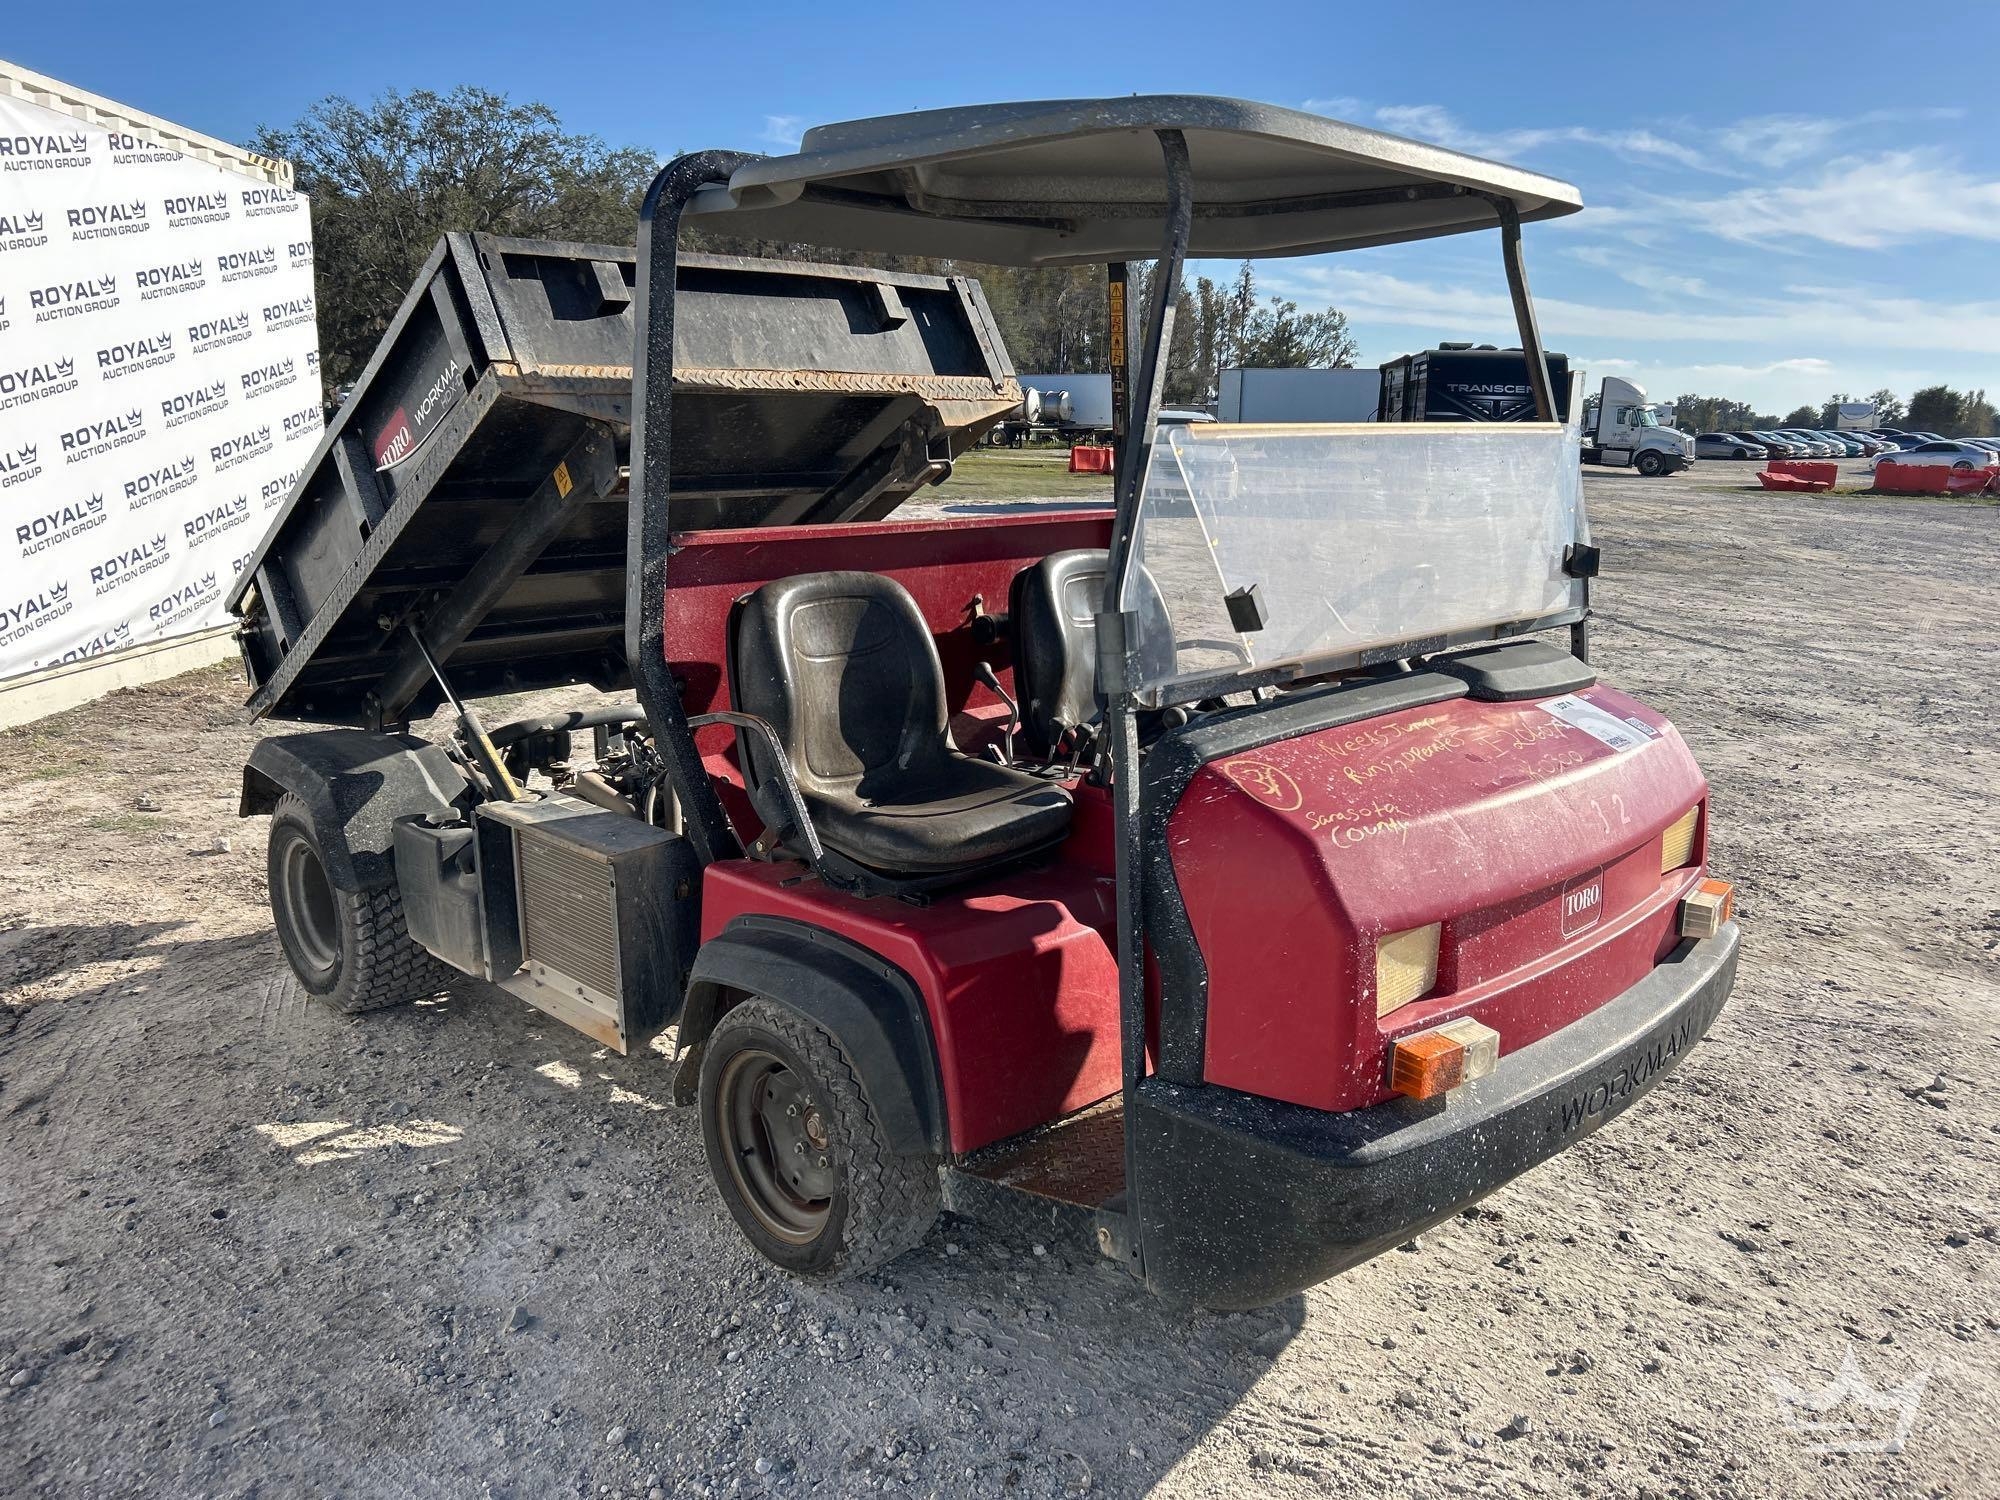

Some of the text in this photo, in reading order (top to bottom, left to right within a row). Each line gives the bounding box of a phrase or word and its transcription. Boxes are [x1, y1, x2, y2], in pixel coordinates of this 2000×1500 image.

[0, 135, 71, 156] ROYAL
[113, 152, 184, 164] AUCTION GROUP
[4, 157, 91, 171] AUCTION GROUP
[164, 195, 215, 215] ROYAL
[242, 189, 286, 206] ROYAL
[246, 204, 298, 218] AUCTION GROUP
[66, 204, 132, 227] ROYAL
[169, 212, 230, 228] AUCTION GROUP
[9, 236, 48, 250] GROUP
[72, 223, 150, 241] AUCTION GROUP
[218, 250, 264, 271] ROYAL
[222, 265, 278, 283] AUCTION GROUP
[136, 264, 190, 288] ROYAL
[30, 280, 100, 308] ROYAL
[140, 280, 206, 301] AUCTION GROUP
[36, 298, 120, 323] AUCTION GROUP
[263, 300, 304, 322] ROYAL
[188, 317, 238, 342] ROYAL
[266, 318, 294, 333] AUCTION
[97, 338, 158, 368] ROYAL
[193, 330, 252, 355] AUCTION GROUP
[0, 364, 57, 394] OYAL
[102, 352, 176, 381] AUCTION GROUP
[241, 363, 284, 389] ROYAL
[41, 380, 78, 398] GROUP
[162, 387, 213, 416] ROYAL
[246, 375, 296, 400] AUCTION GROUP
[414, 360, 459, 426] WORKMA
[1447, 384, 1534, 394] TRANSCEN
[166, 400, 228, 429] AUCTION GROUP
[60, 416, 128, 451] ROYAL
[66, 430, 146, 465] AUCTION GROUP
[210, 432, 260, 462] ROYAL
[286, 425, 313, 442] AUCTION
[215, 442, 274, 474] AUCTION GROUP
[2, 466, 42, 488] GROUP
[124, 464, 182, 498] ROYAL
[129, 474, 198, 511] AUCTION GROUP
[16, 503, 88, 544] ROYAL
[184, 503, 234, 538] ROYAL
[188, 512, 250, 550] AUCTION GROUP
[22, 514, 107, 558] AUCTION GROUP
[90, 544, 152, 584] ROYAL
[96, 552, 170, 597] AUCTION GROUP
[0, 594, 52, 632] OYAL
[150, 581, 205, 621] ROYAL
[154, 589, 222, 633] AUCTION GROUP
[0, 602, 72, 647] CTION GROUP
[1305, 801, 1404, 830] Sarasota
[1331, 818, 1410, 849] County
[1565, 884, 1600, 916] TORO
[1561, 1018, 1691, 1133] WORKMAN
